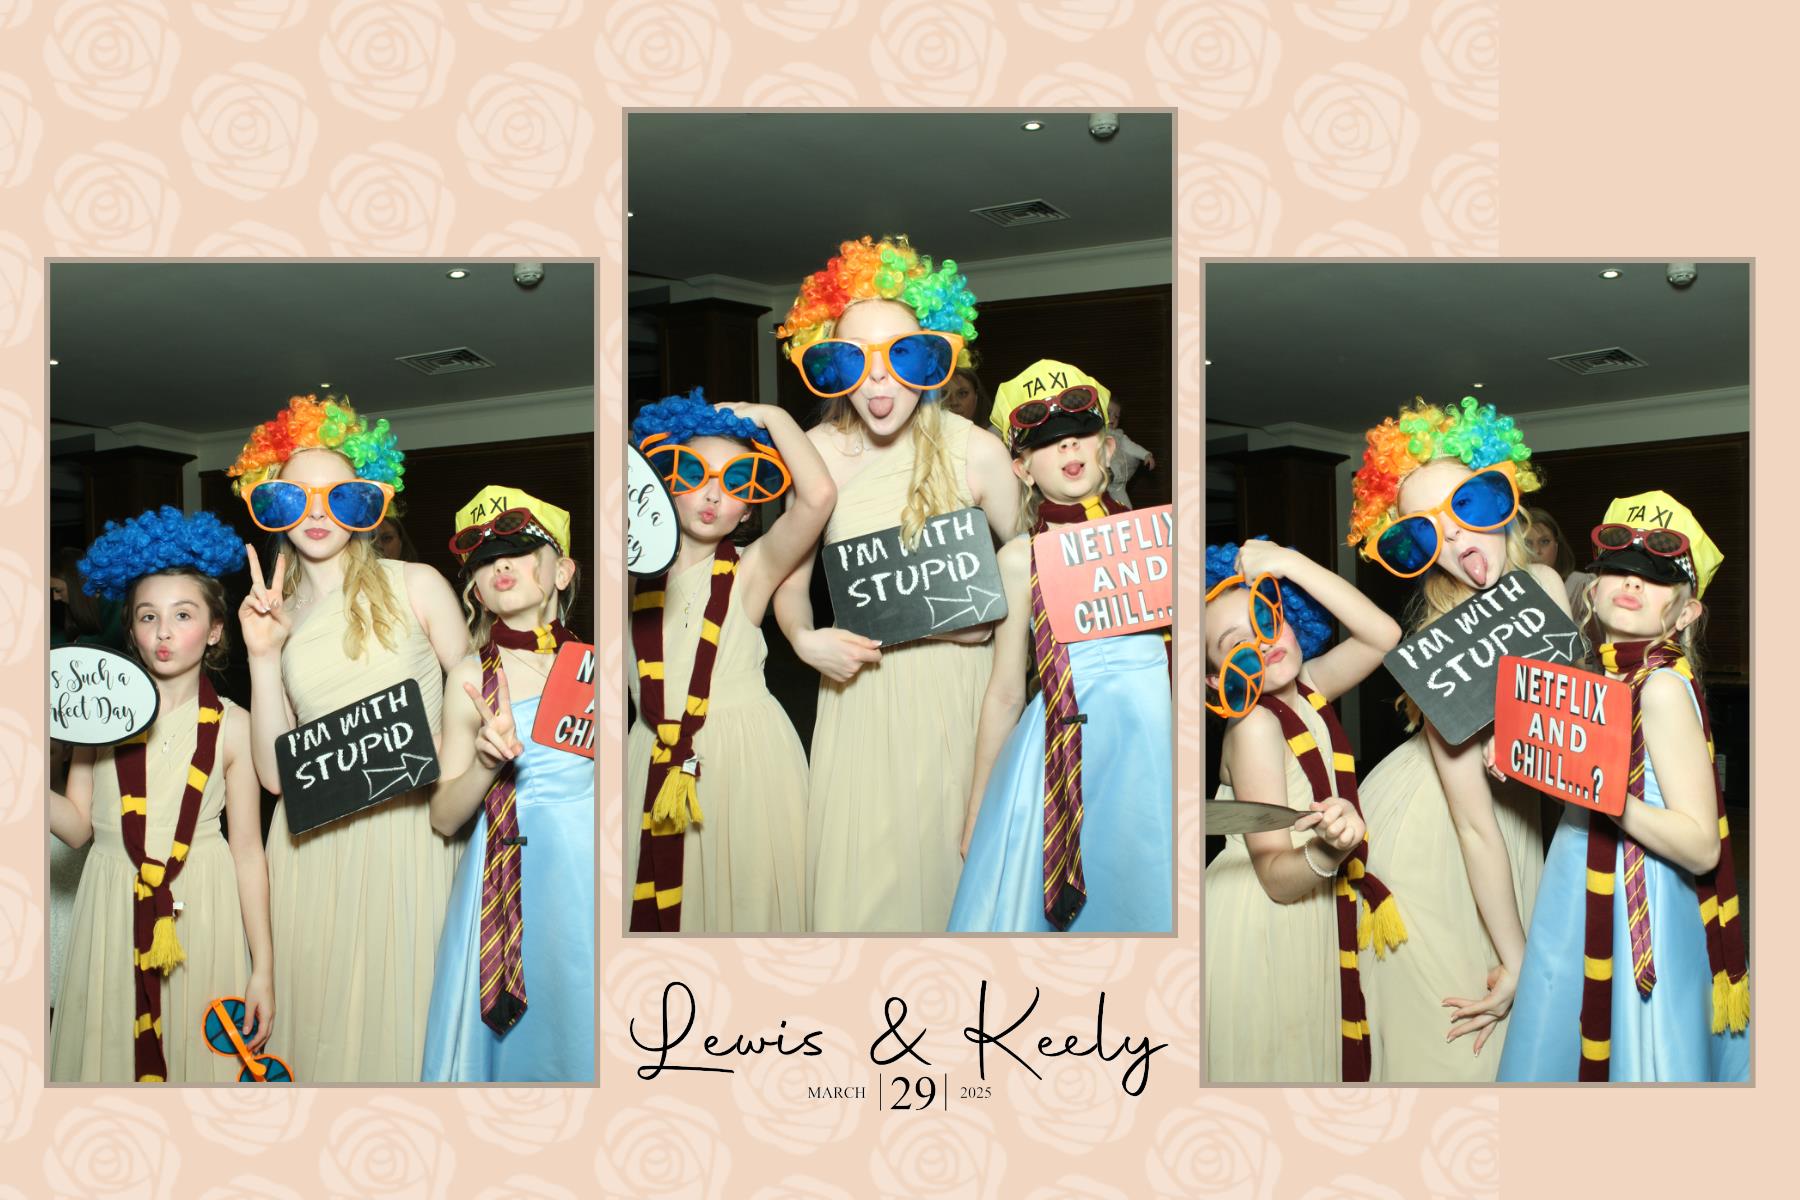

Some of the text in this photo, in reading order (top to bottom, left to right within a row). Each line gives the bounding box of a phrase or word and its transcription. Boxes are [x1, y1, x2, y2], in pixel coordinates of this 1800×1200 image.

[651, 511, 663, 527] a
[837, 537, 889, 571] I'M
[1093, 555, 1169, 593] AND
[1397, 627, 1455, 670] I'M
[67, 658, 114, 693] Such
[118, 672, 130, 687] a
[1515, 663, 1608, 725] NETFLIX
[92, 696, 136, 732] Day
[288, 722, 331, 757] I'M
[1528, 712, 1587, 753] AND
